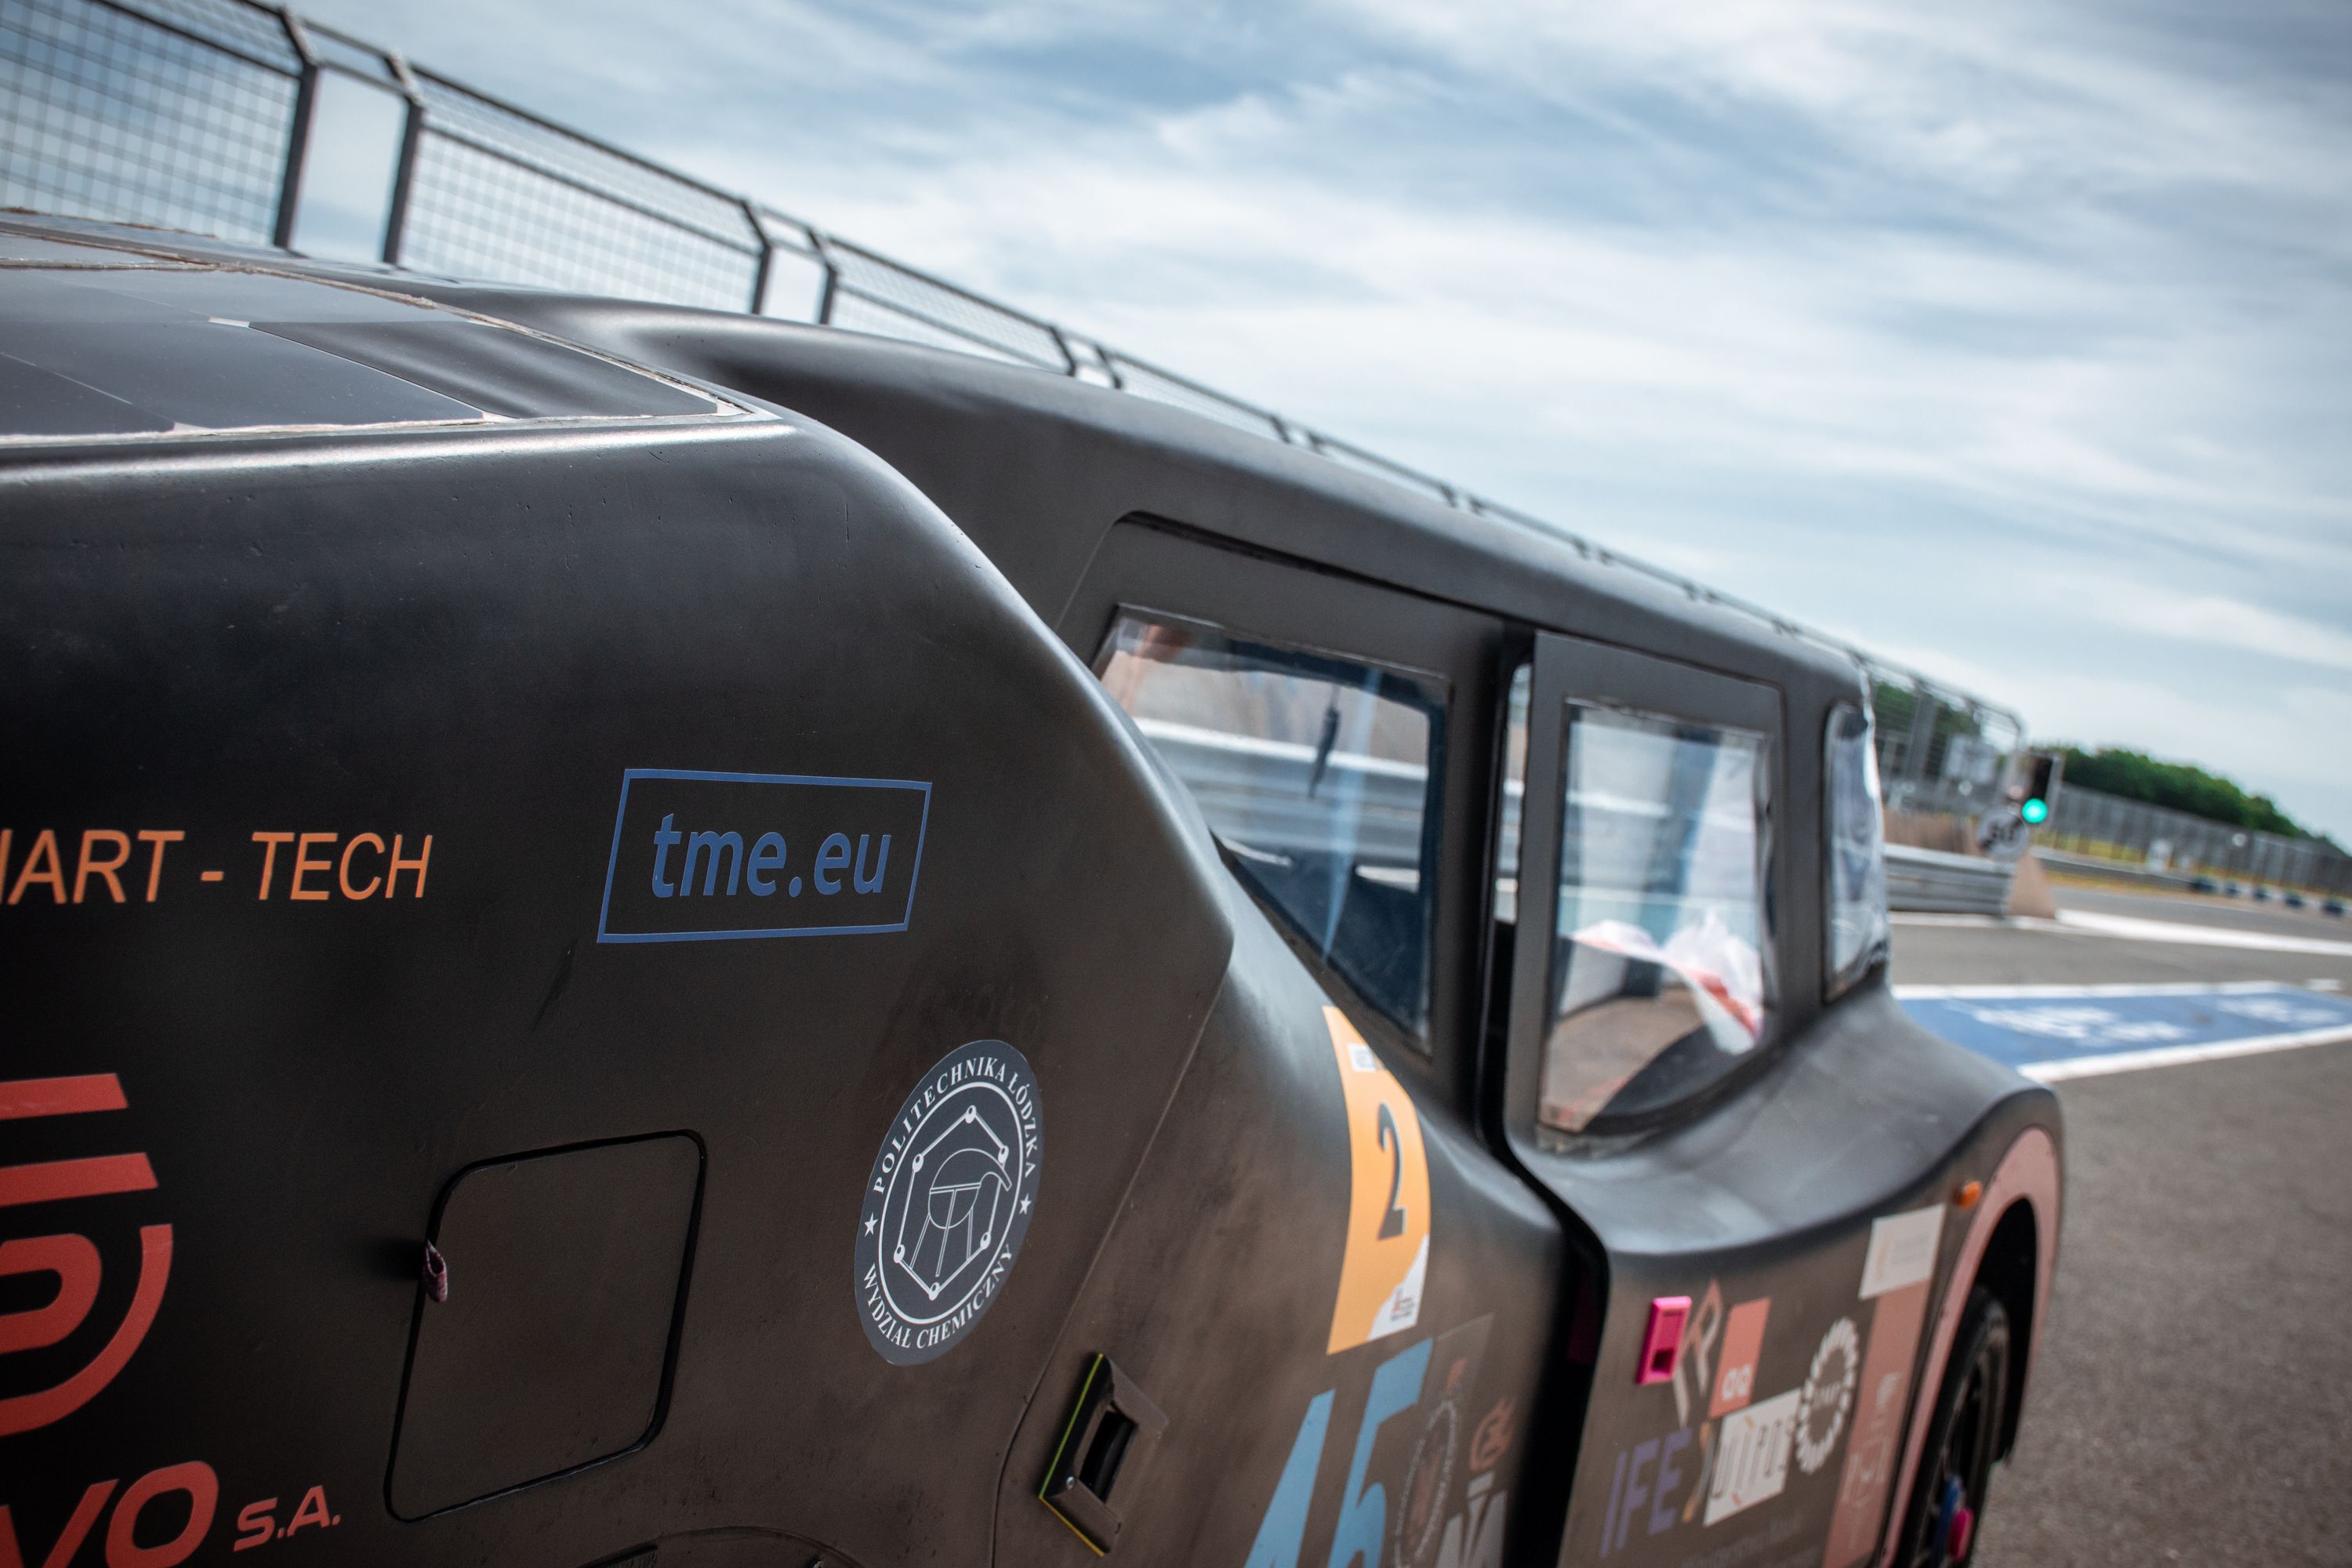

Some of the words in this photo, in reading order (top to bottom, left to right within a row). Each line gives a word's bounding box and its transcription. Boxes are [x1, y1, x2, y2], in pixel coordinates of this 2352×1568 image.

[252, 831, 433, 901] TECH
[652, 813, 891, 898] tme.eu
[873, 1056, 1007, 1194] POLITECHNIKA
[1007, 1072, 1038, 1178] ŁÓDZKA
[1377, 1101, 1407, 1241] 2
[863, 1262, 912, 1349] WYDZIAŁ
[916, 1243, 1013, 1350] CHEMICZNY
[233, 1484, 342, 1552] S.A.
